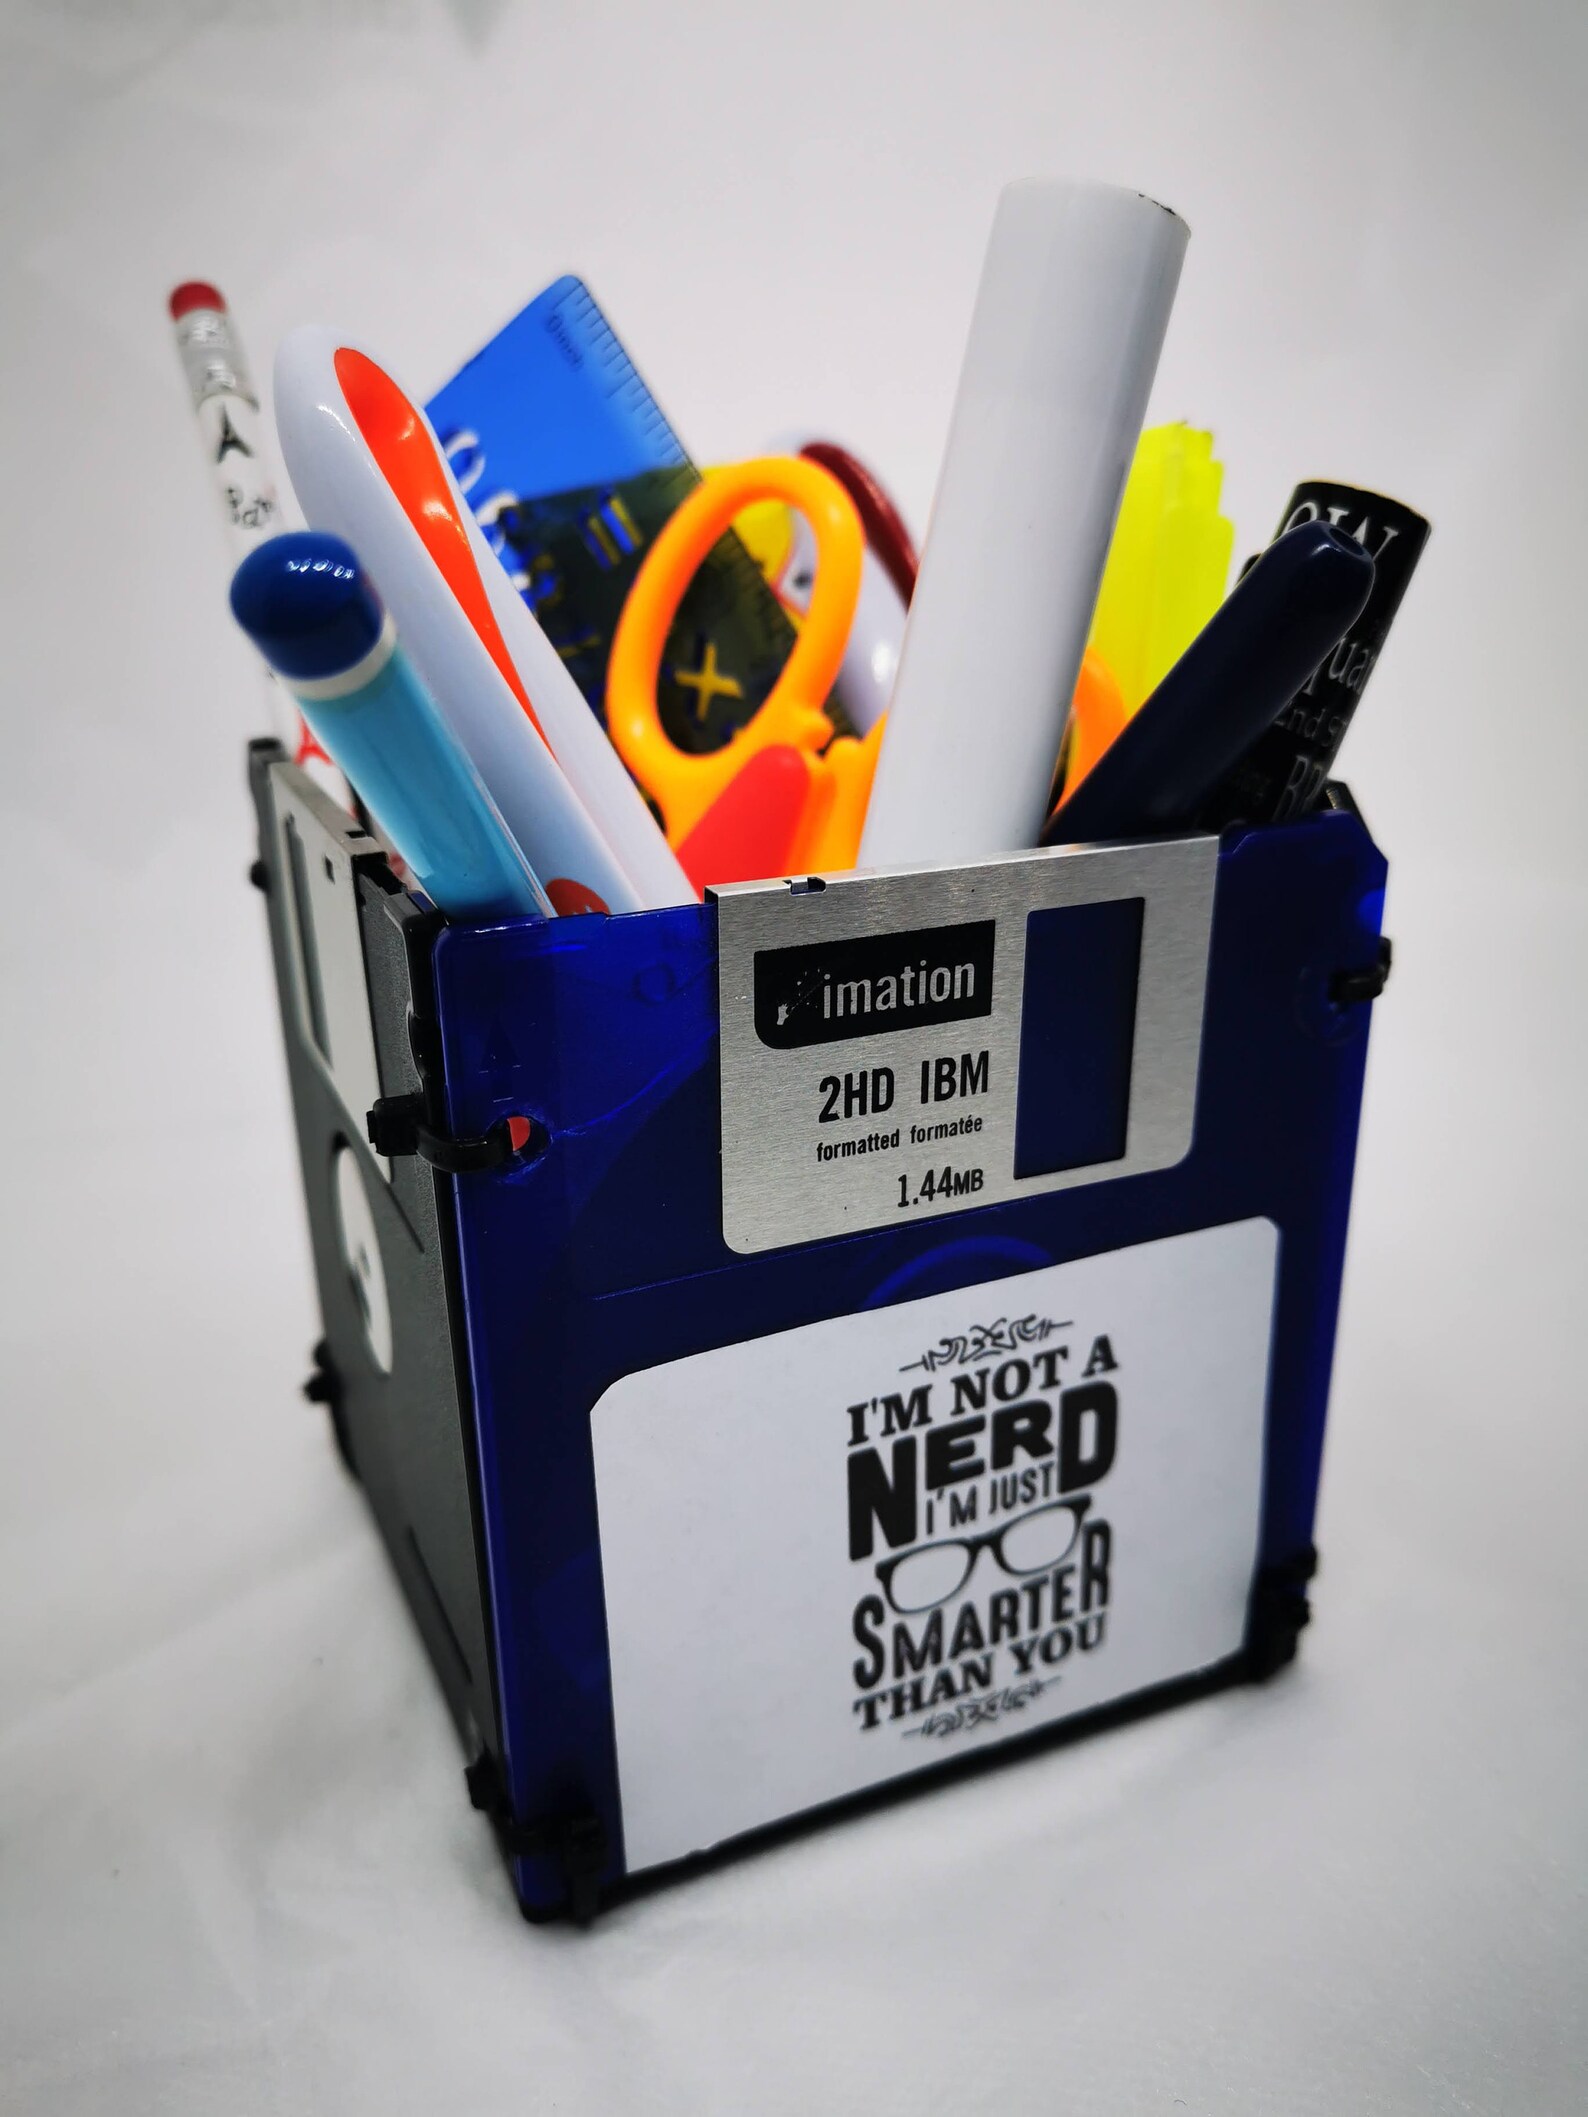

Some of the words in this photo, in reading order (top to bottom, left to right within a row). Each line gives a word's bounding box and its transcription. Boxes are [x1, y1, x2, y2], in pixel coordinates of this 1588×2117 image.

[823, 960, 975, 1019] imation
[818, 1067, 895, 1123] 2HD
[920, 1050, 990, 1104] IBM
[816, 1128, 901, 1162] formatted
[910, 1114, 983, 1144] formatée
[897, 1166, 984, 1208] 1.44MB
[847, 1383, 932, 1446] I'M
[950, 1346, 1068, 1415] NOT
[1081, 1334, 1119, 1378] A
[847, 1380, 1118, 1562] NERD
[926, 1487, 978, 1535] I'M
[988, 1461, 1055, 1516] JUST
[852, 1518, 1112, 1689] SMARTER
[852, 1651, 993, 1731] THAN
[1010, 1610, 1106, 1676] YOU
